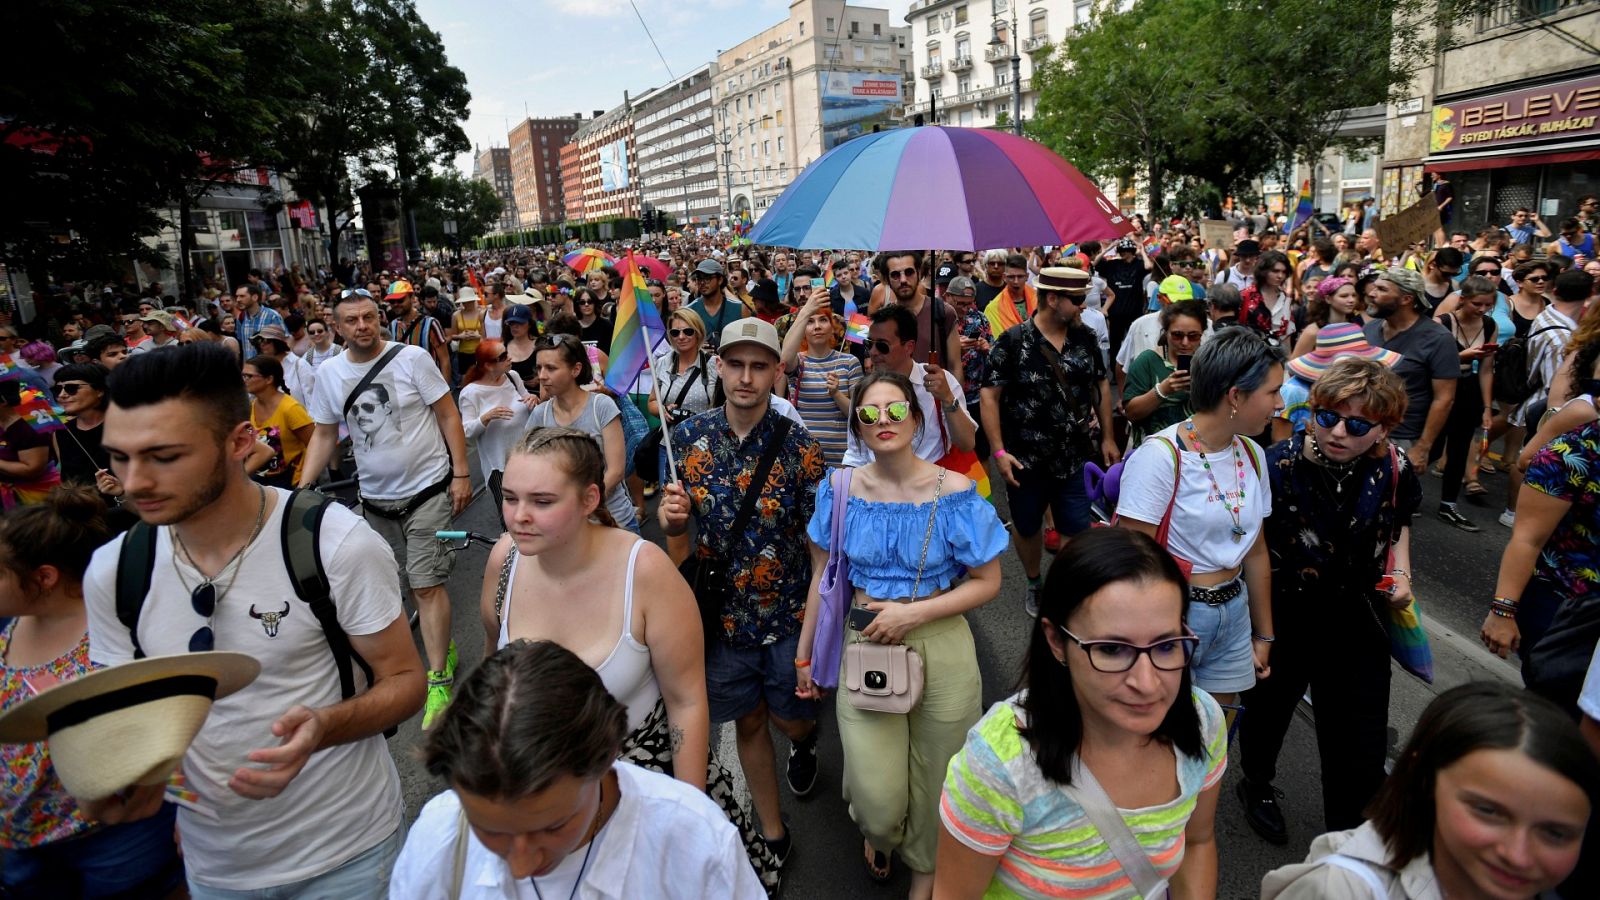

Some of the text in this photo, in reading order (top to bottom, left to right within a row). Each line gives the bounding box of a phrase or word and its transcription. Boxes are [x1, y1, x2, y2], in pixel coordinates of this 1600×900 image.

[1459, 115, 1597, 144] EGYEDI TÁSKÁK, RUHÁZAT
